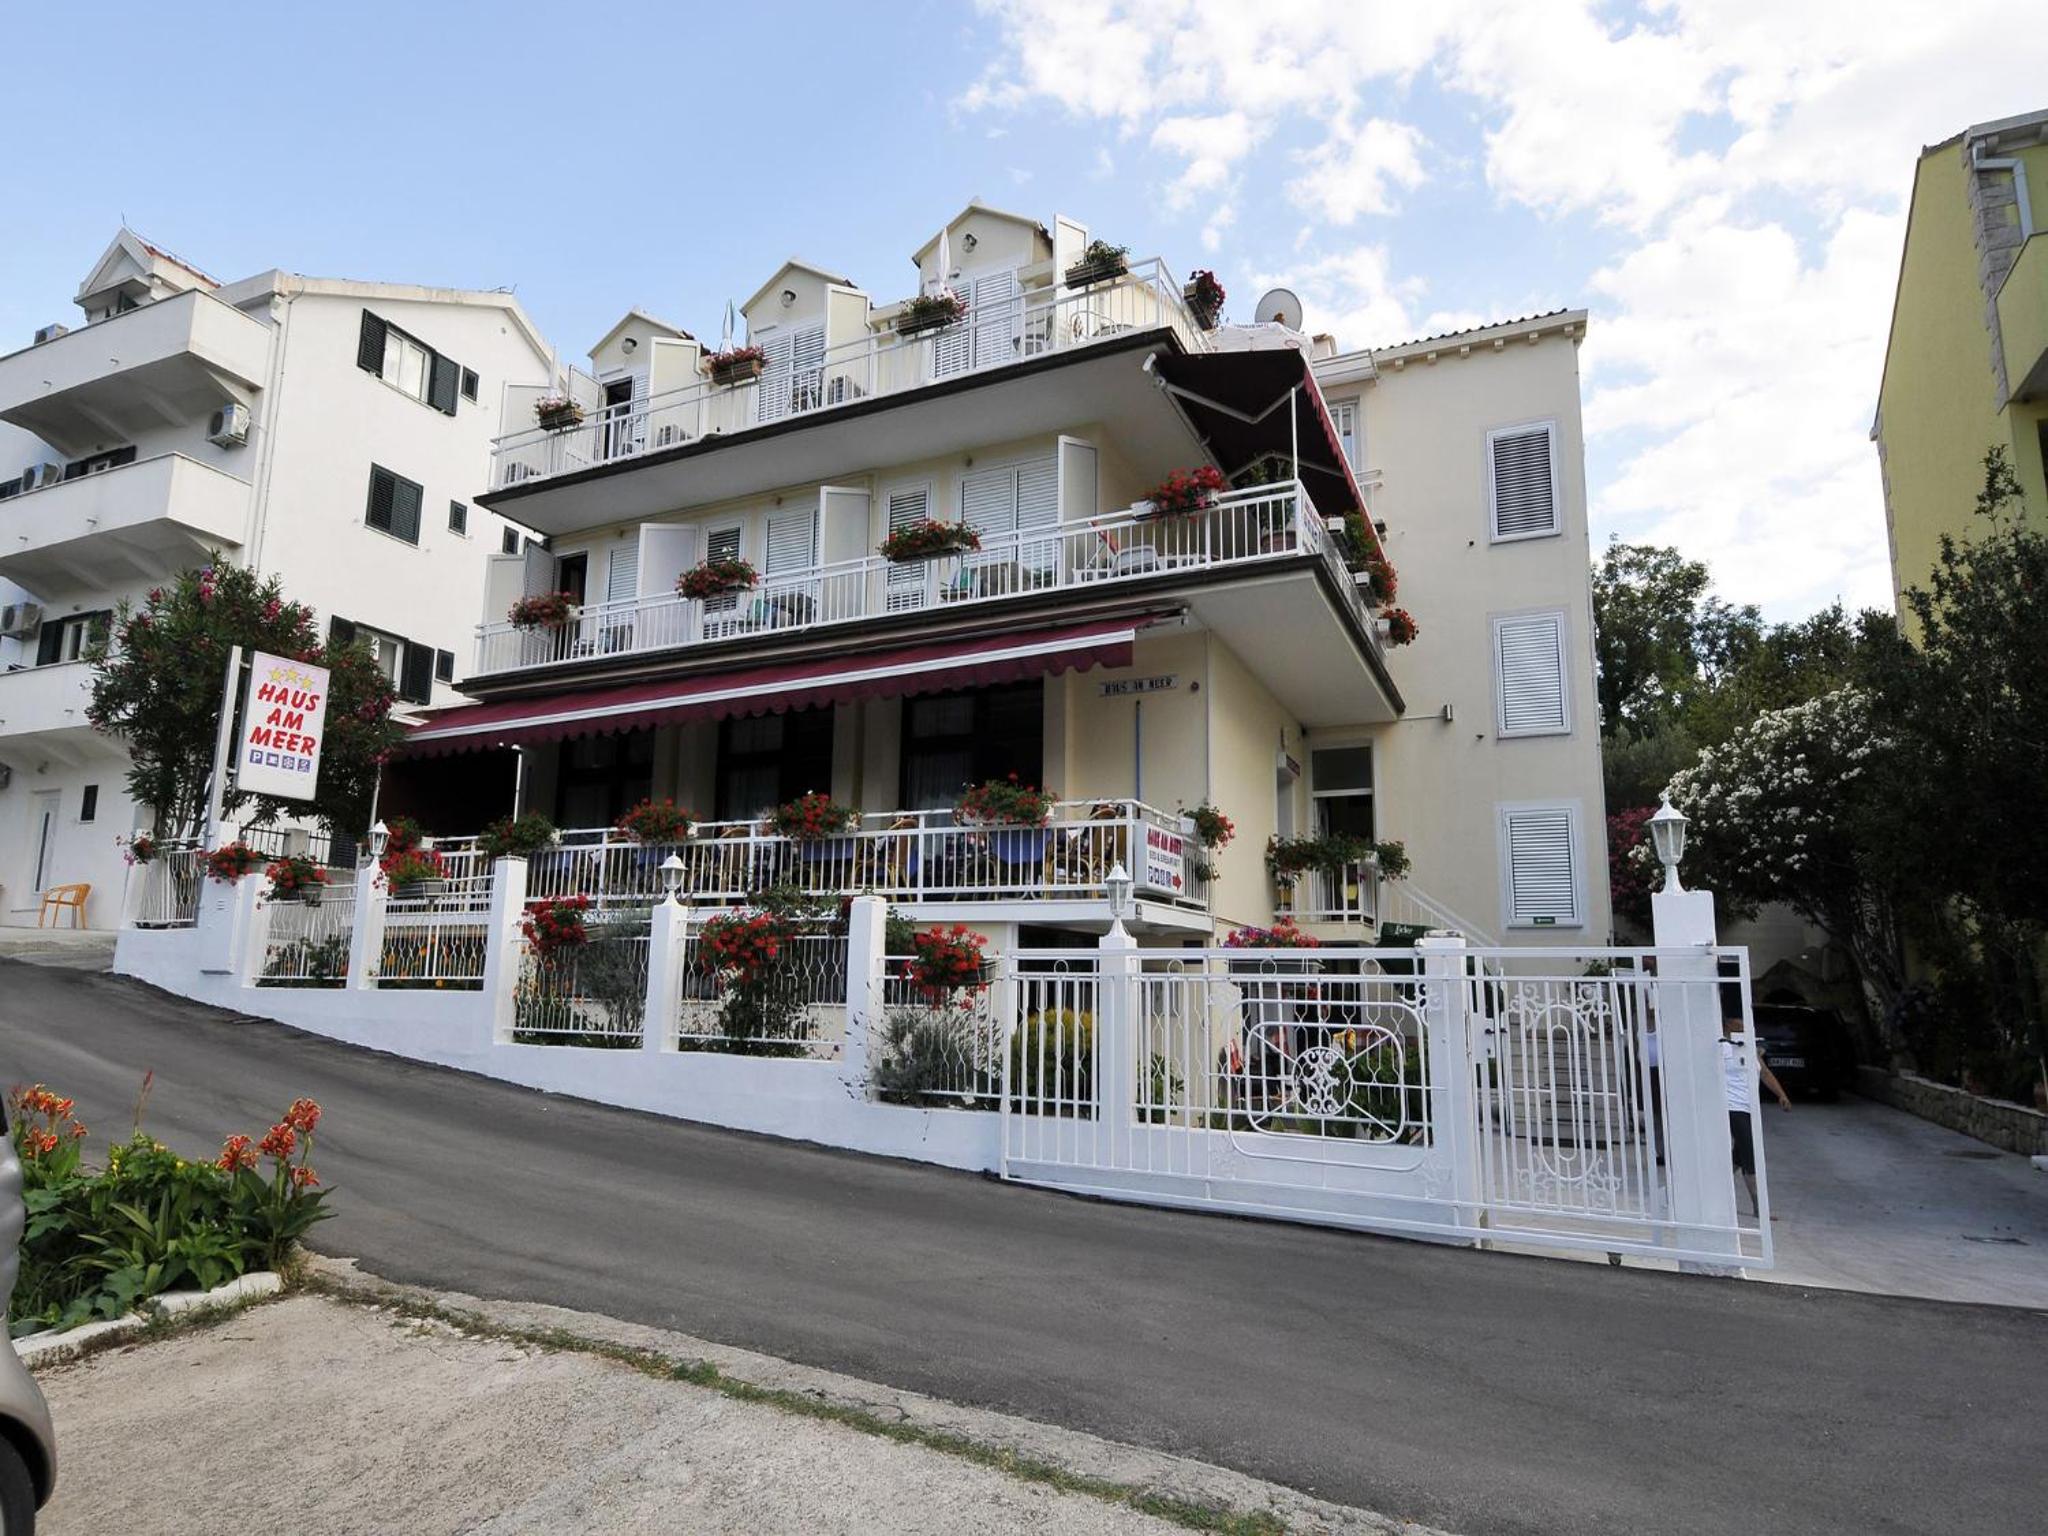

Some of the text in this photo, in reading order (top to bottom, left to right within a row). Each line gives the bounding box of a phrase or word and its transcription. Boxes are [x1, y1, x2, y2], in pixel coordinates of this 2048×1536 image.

[257, 682, 321, 712] HAUS
[266, 708, 304, 731] AM
[249, 726, 317, 756] MEER
